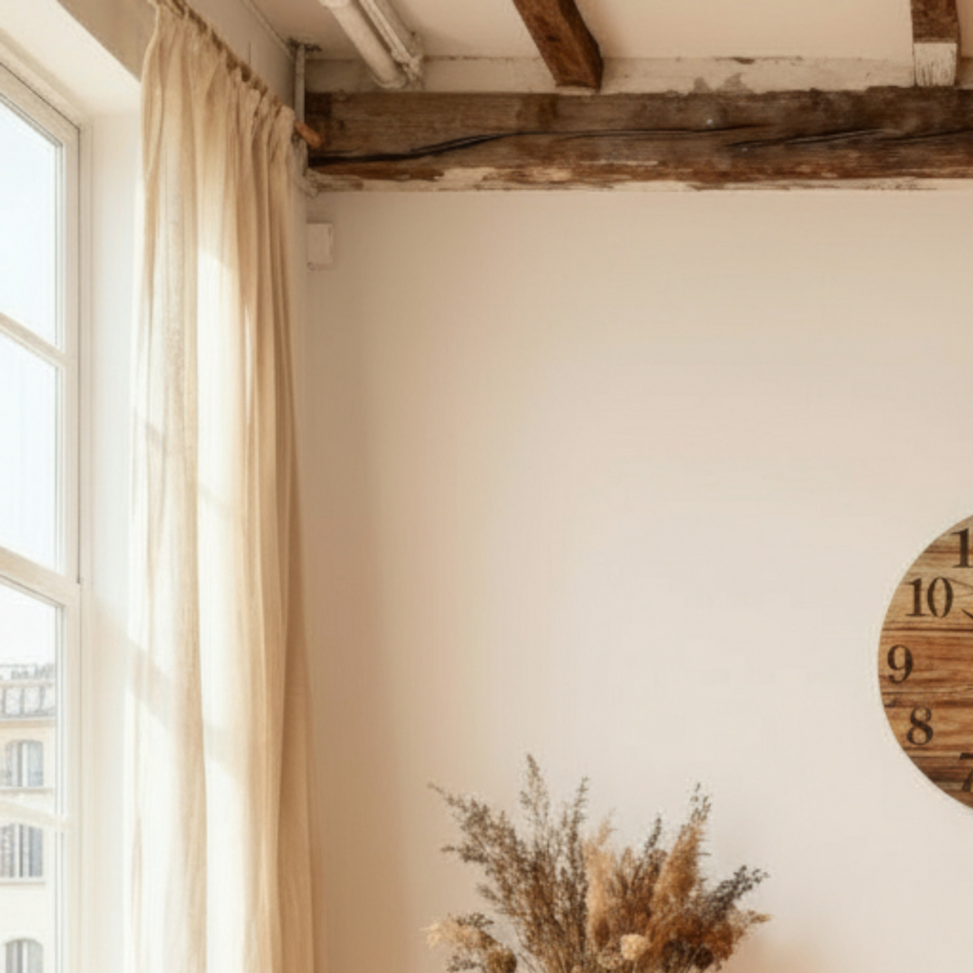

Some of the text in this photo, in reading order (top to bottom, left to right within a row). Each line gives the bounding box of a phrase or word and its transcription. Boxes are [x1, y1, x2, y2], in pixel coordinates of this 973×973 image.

[905, 577, 953, 618] 10
[887, 645, 913, 684] 9
[906, 706, 933, 745] 8
